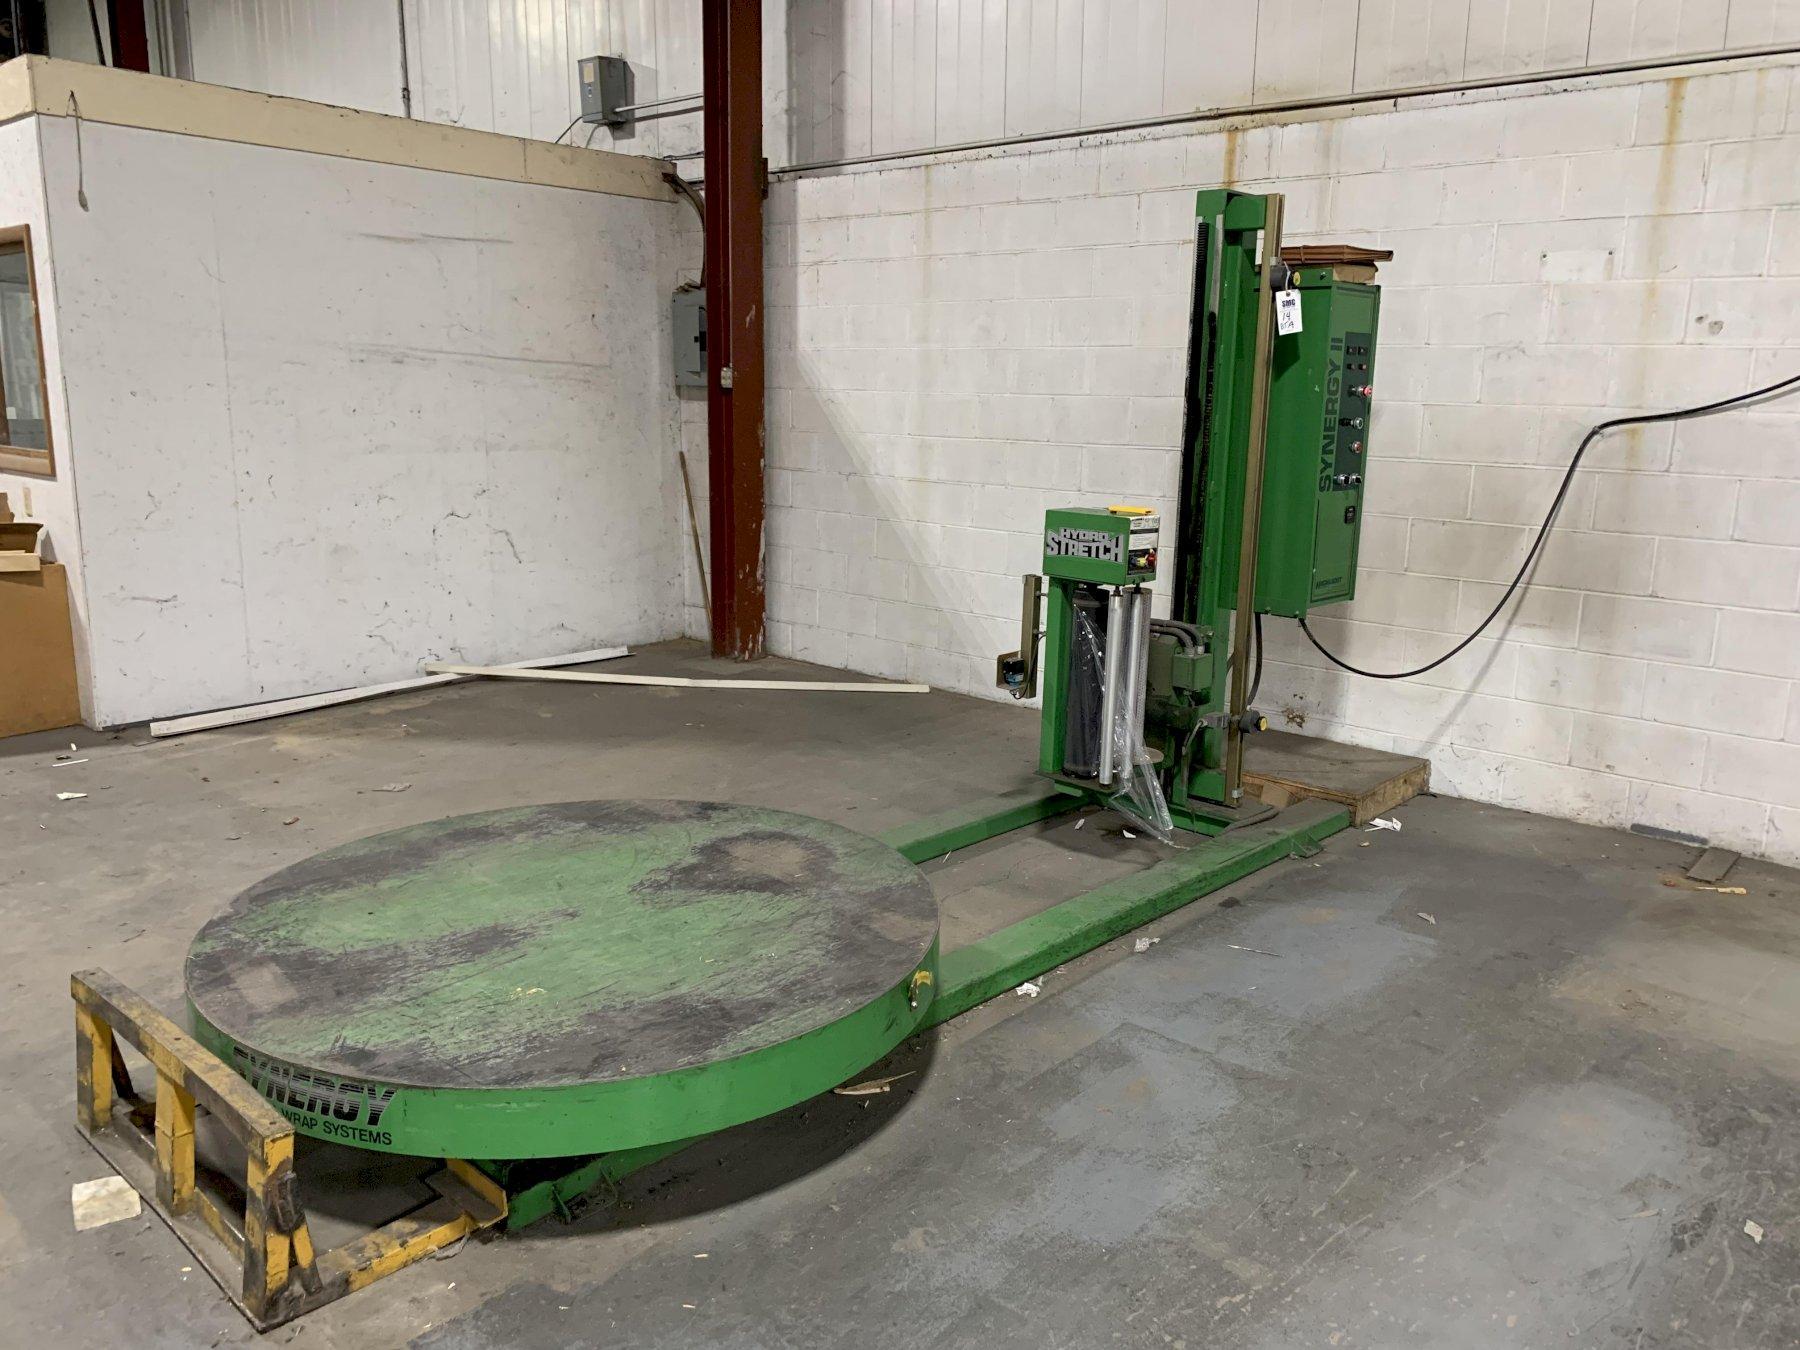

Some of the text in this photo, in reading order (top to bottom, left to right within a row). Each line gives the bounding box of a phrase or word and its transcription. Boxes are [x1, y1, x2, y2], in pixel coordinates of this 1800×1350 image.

[1318, 337, 1344, 493] SYNERGY II
[1046, 530, 1124, 563] STRETCH
[1060, 527, 1109, 542] HYDRO
[281, 1108, 392, 1145] WRAP SYSTEMS
